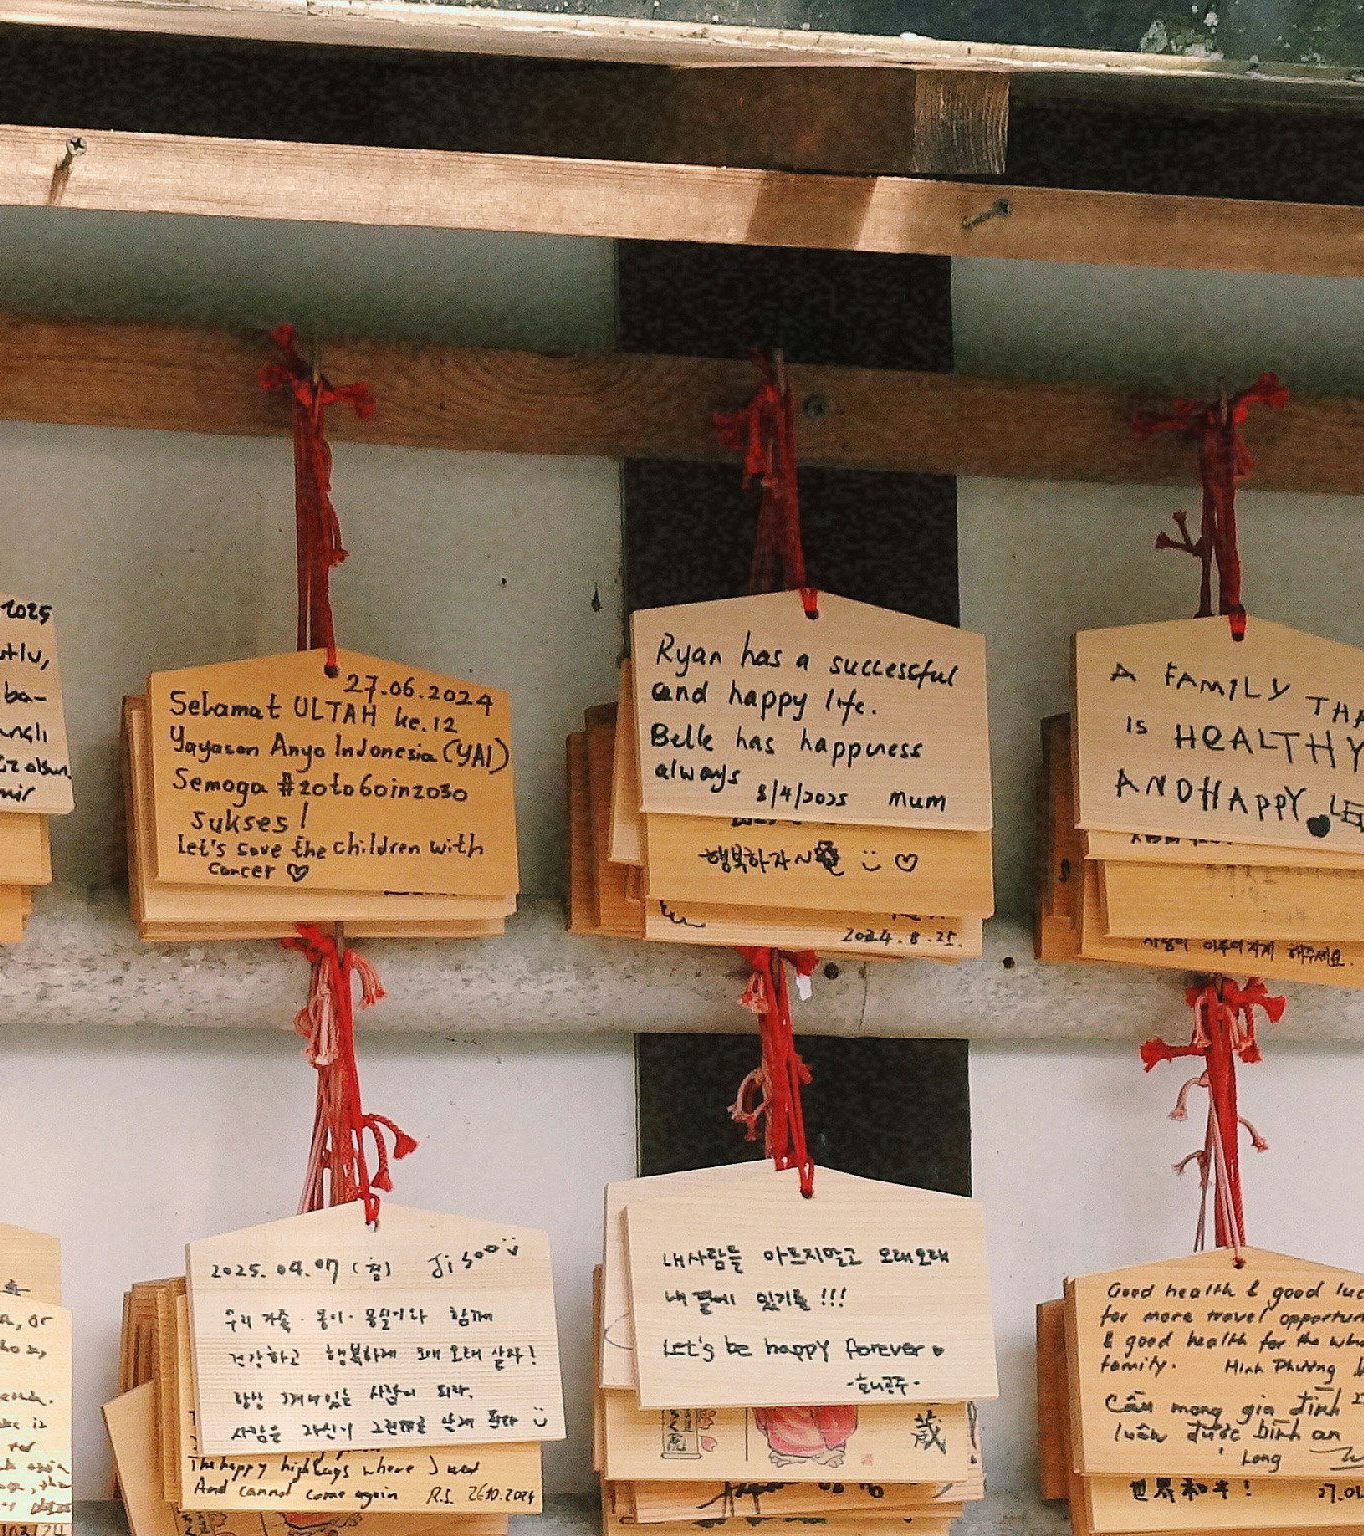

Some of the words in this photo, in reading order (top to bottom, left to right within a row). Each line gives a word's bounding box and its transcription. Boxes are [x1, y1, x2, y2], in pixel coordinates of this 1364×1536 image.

[656, 632, 722, 678] Ryan
[740, 630, 783, 668] has
[795, 653, 809, 671] a
[829, 655, 959, 690] successful
[1109, 663, 1137, 682] A
[1164, 661, 1291, 702] FAMILY
[169, 690, 282, 721] Selamat
[293, 695, 377, 727] ULTAH
[651, 680, 709, 705] and
[728, 679, 808, 722] happy
[650, 722, 714, 752] Belle
[736, 725, 775, 755] has
[800, 727, 923, 769] happiness
[172, 767, 269, 809] Semoga
[654, 758, 741, 794] always
[290, 834, 327, 860] the
[332, 831, 421, 856] children
[429, 832, 484, 859] with
[1142, 1311, 1193, 1324] more
[1206, 1305, 1265, 1324] travel
[663, 1336, 715, 1363] Let's
[724, 1335, 753, 1357] be
[764, 1338, 830, 1363] happy
[845, 1337, 925, 1360] forever
[1124, 1330, 1174, 1359] good
[1258, 1330, 1286, 1354] for
